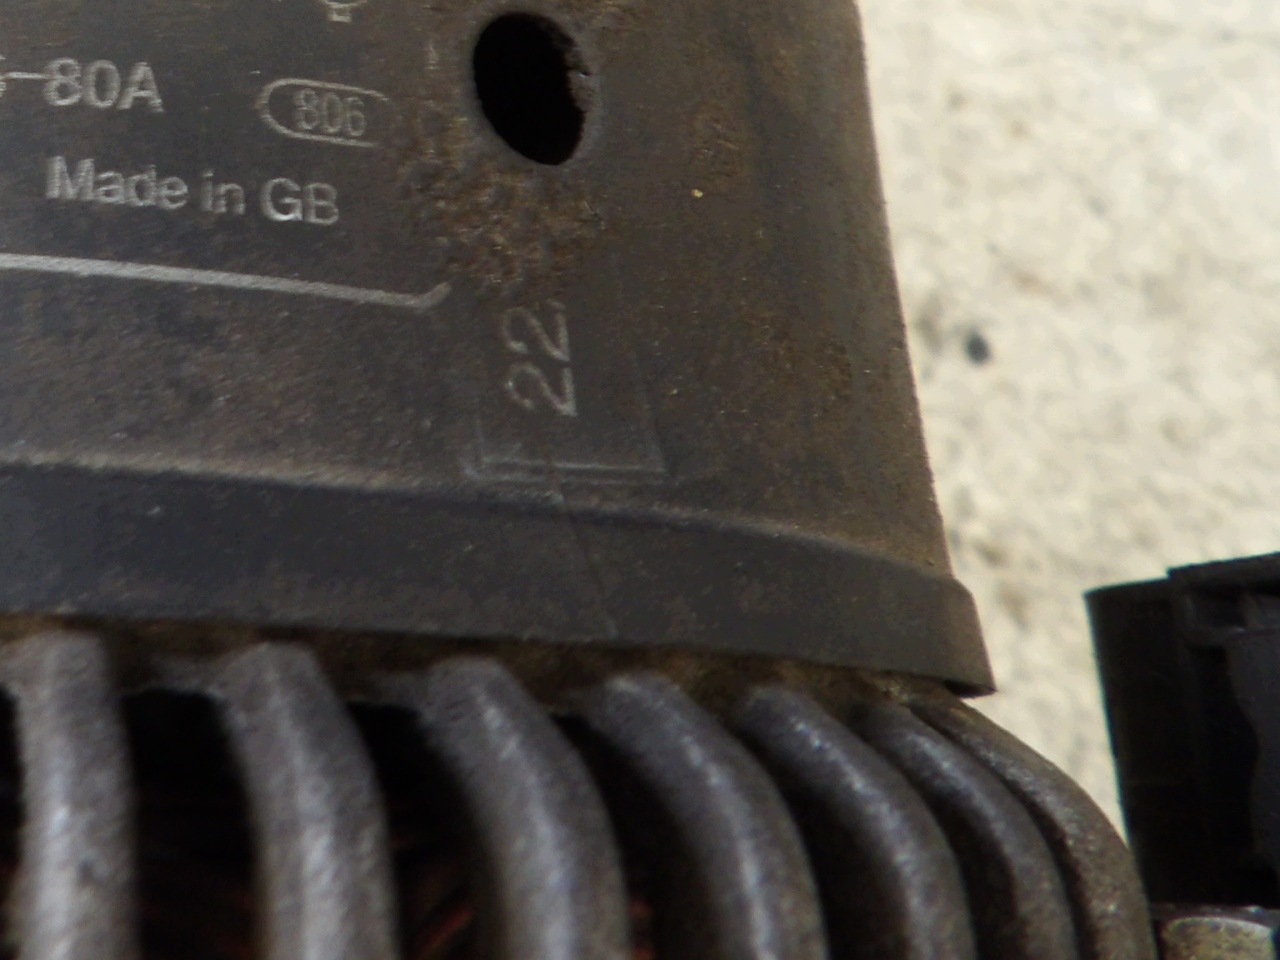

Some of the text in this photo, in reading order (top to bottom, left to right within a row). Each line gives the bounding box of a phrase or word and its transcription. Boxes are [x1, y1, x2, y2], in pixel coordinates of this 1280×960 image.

[44, 155, 340, 226] Made in GB
[500, 300, 579, 418] 22
